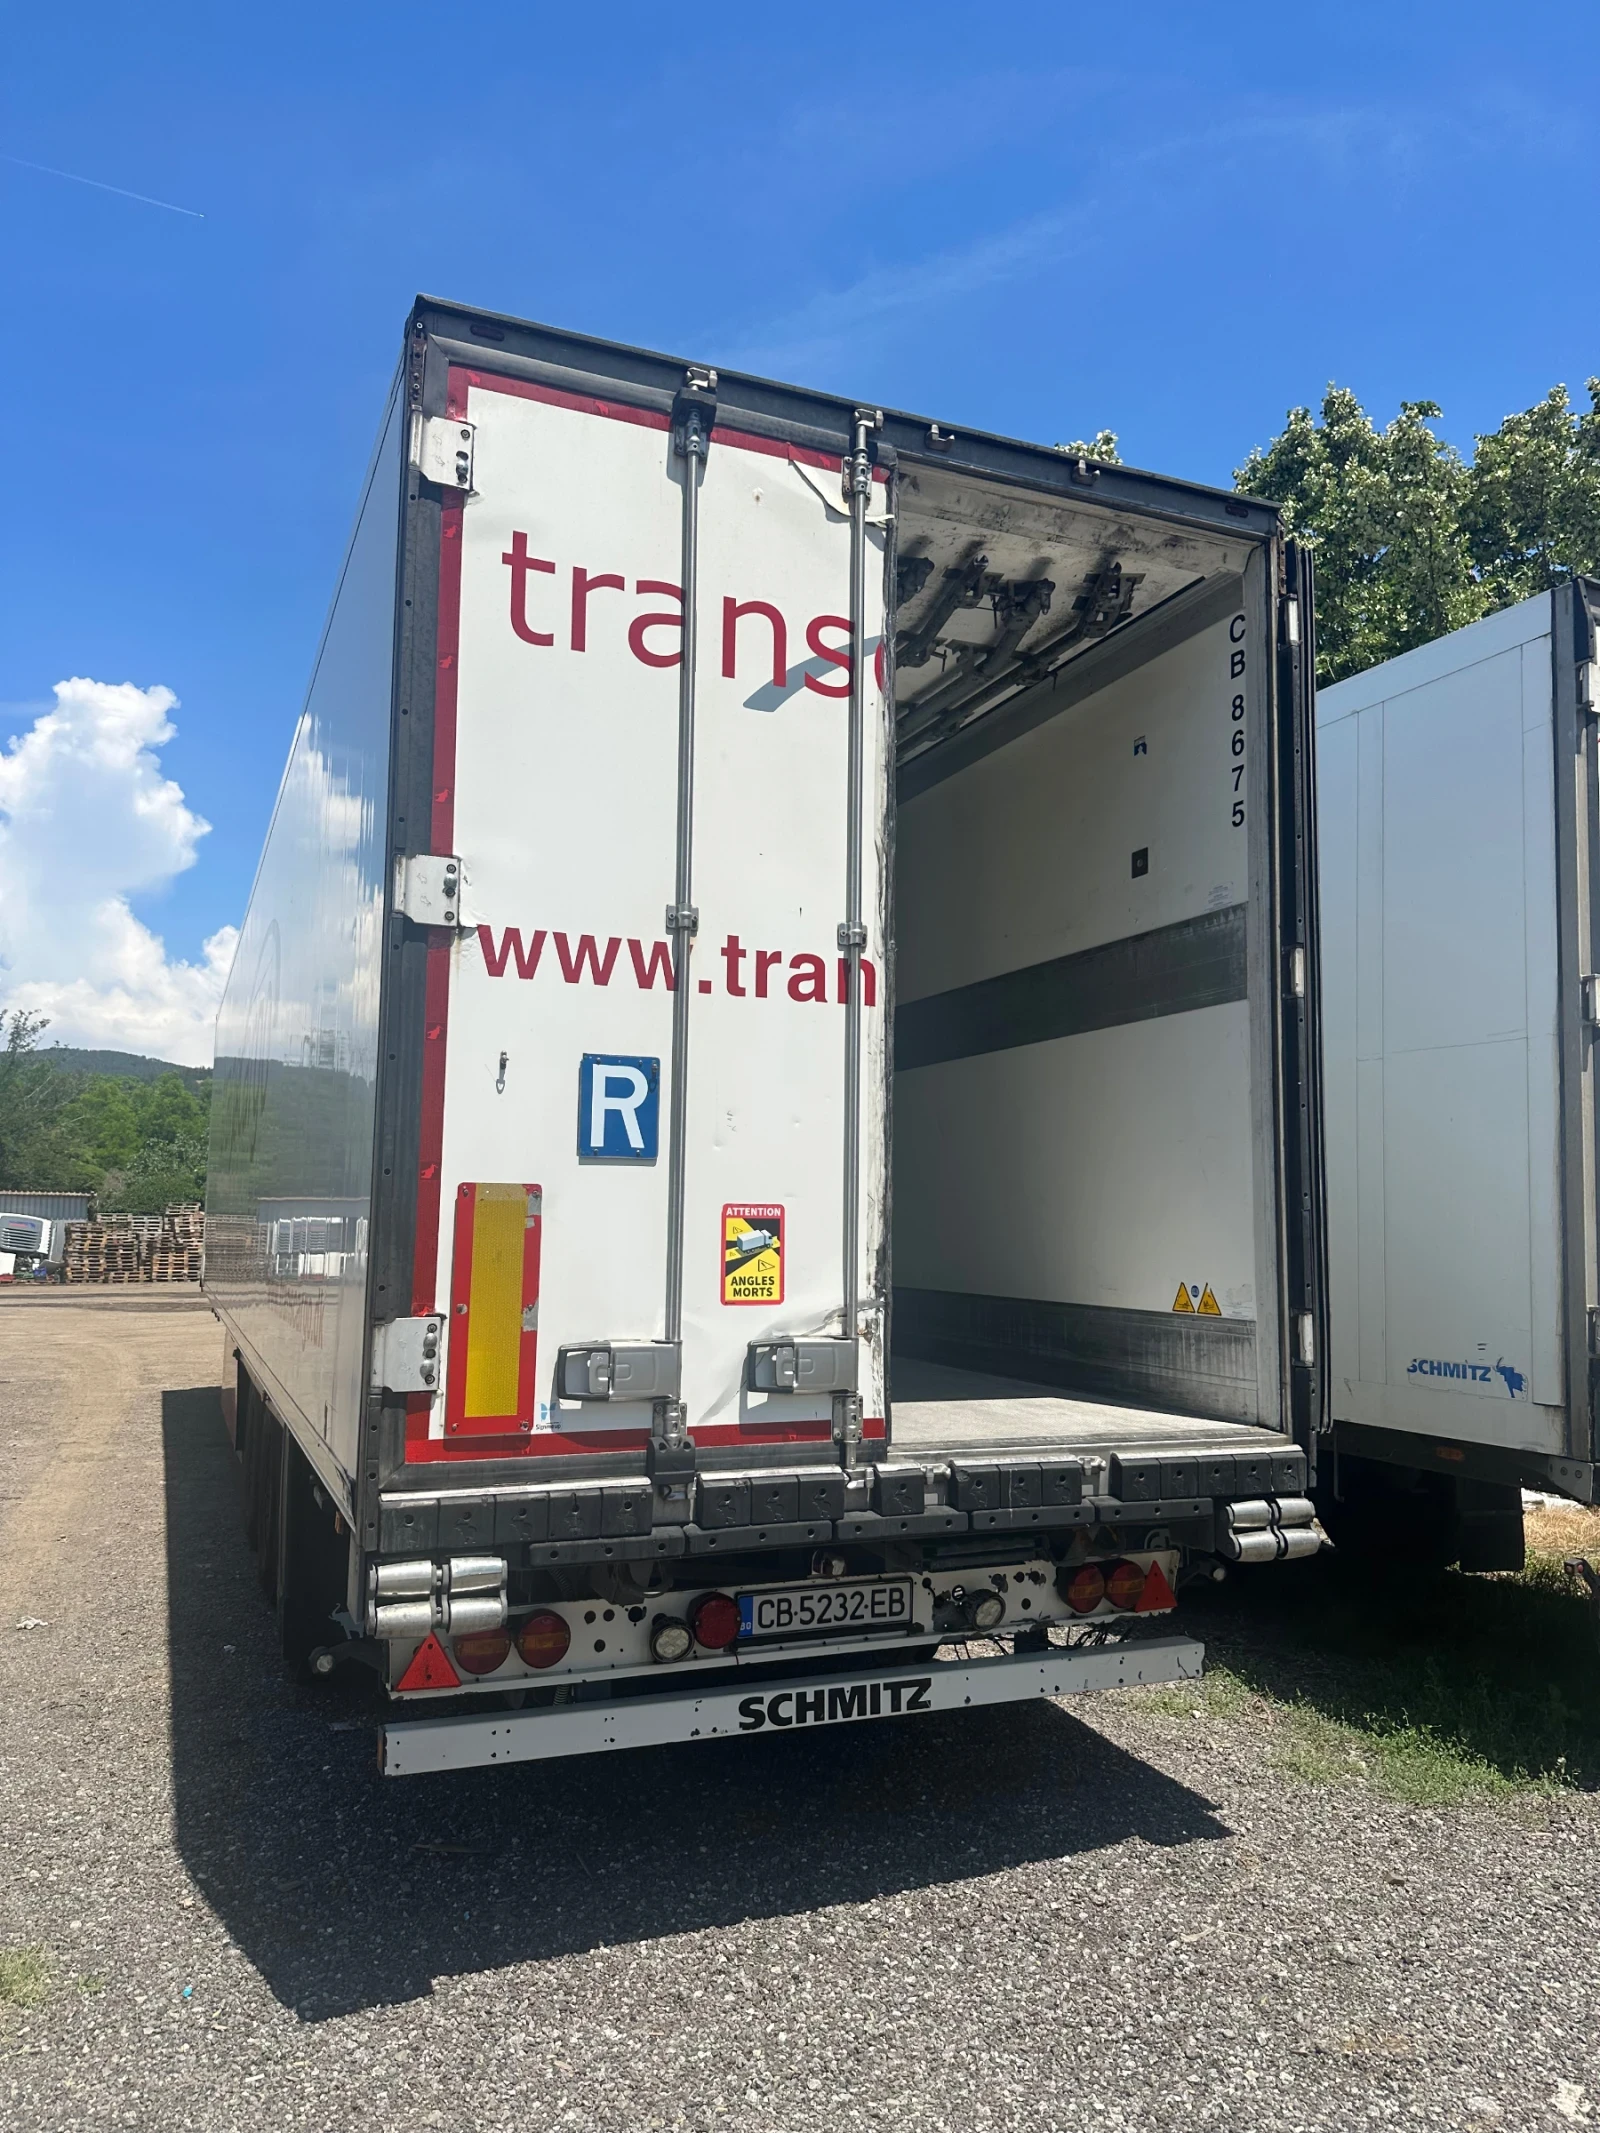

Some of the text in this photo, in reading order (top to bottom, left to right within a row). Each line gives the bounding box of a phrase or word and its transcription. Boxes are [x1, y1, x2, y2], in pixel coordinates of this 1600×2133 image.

[501, 530, 888, 699] trans
[590, 1063, 649, 1149] R
[726, 1207, 781, 1217] ATTENTION
[730, 1276, 775, 1286] ANGLES
[733, 1287, 773, 1297] MORTS
[738, 1677, 932, 1731] SCHMITZ
